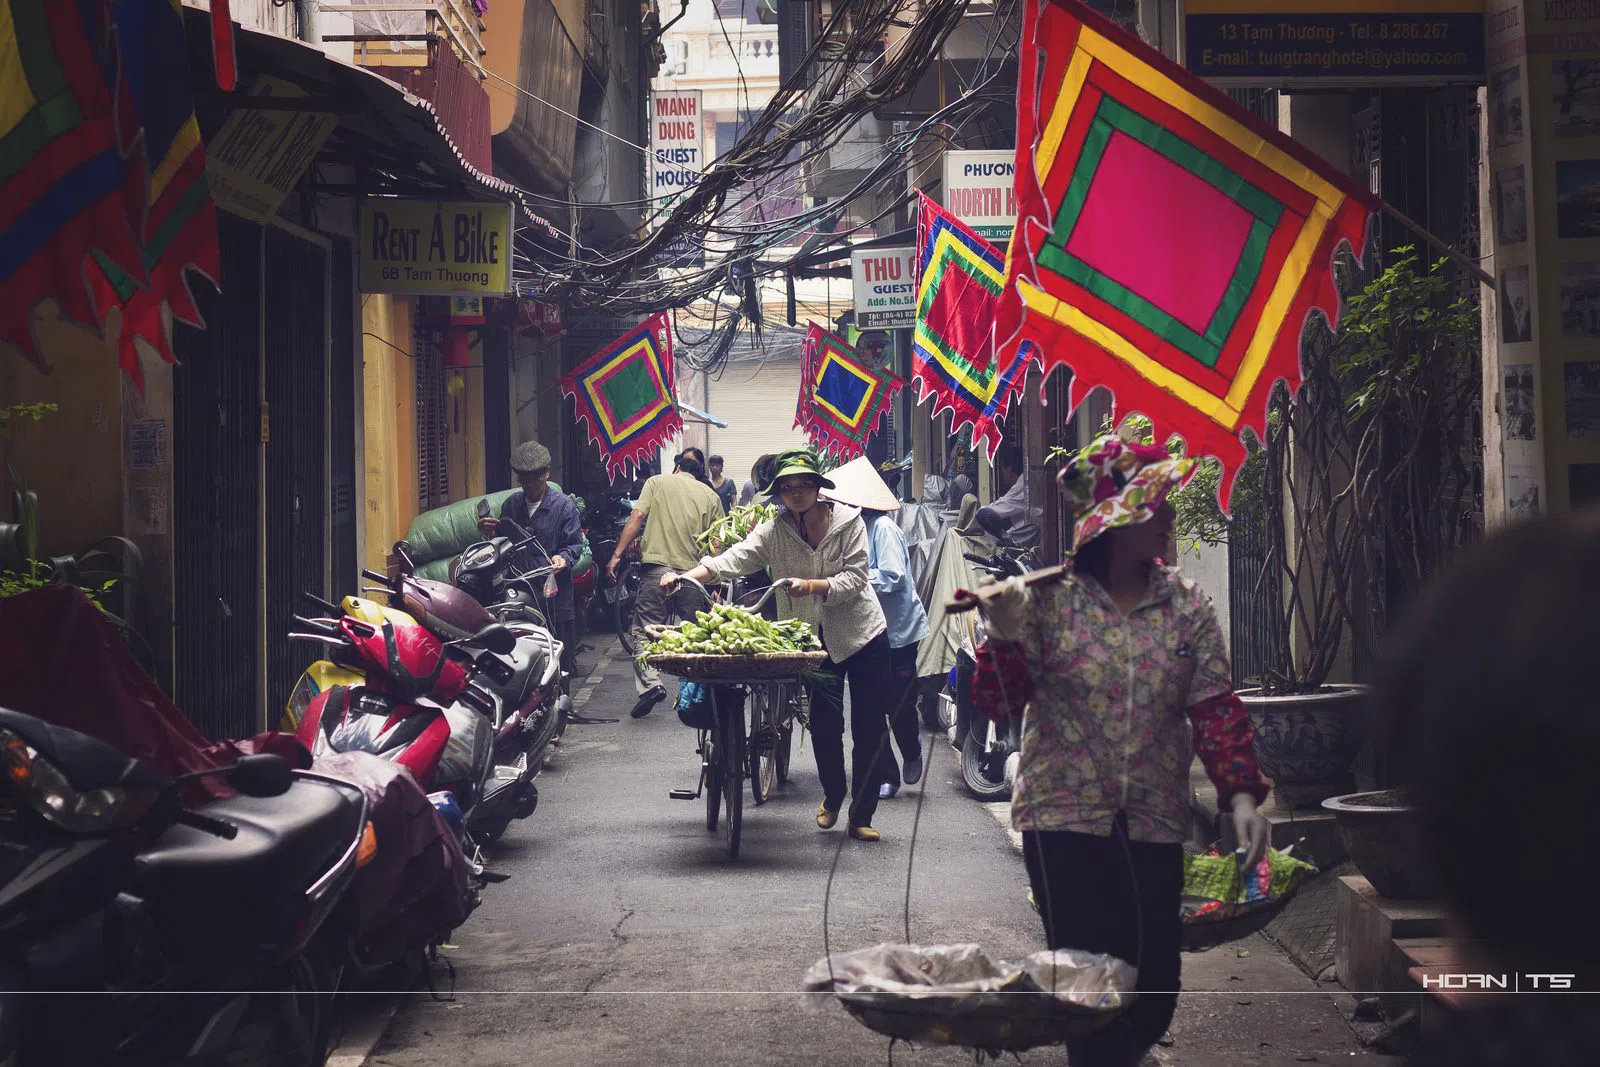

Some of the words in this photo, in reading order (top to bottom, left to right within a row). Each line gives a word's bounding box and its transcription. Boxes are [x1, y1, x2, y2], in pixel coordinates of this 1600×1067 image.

[1220, 23, 1237, 40] 13
[1348, 22, 1375, 40] Tel:
[1202, 48, 1254, 65] E-mail:
[655, 98, 697, 117] MANH
[658, 121, 696, 140] DUNG
[655, 148, 698, 164] GUEST
[655, 170, 700, 188] HOUSE
[949, 187, 1002, 218] NORTH
[428, 211, 447, 263] A
[382, 266, 400, 280] 6B
[404, 267, 432, 281] Tam
[436, 268, 489, 286] Thuong
[861, 256, 902, 282] THU
[873, 283, 914, 294] GUEST
[867, 297, 887, 307] Add:
